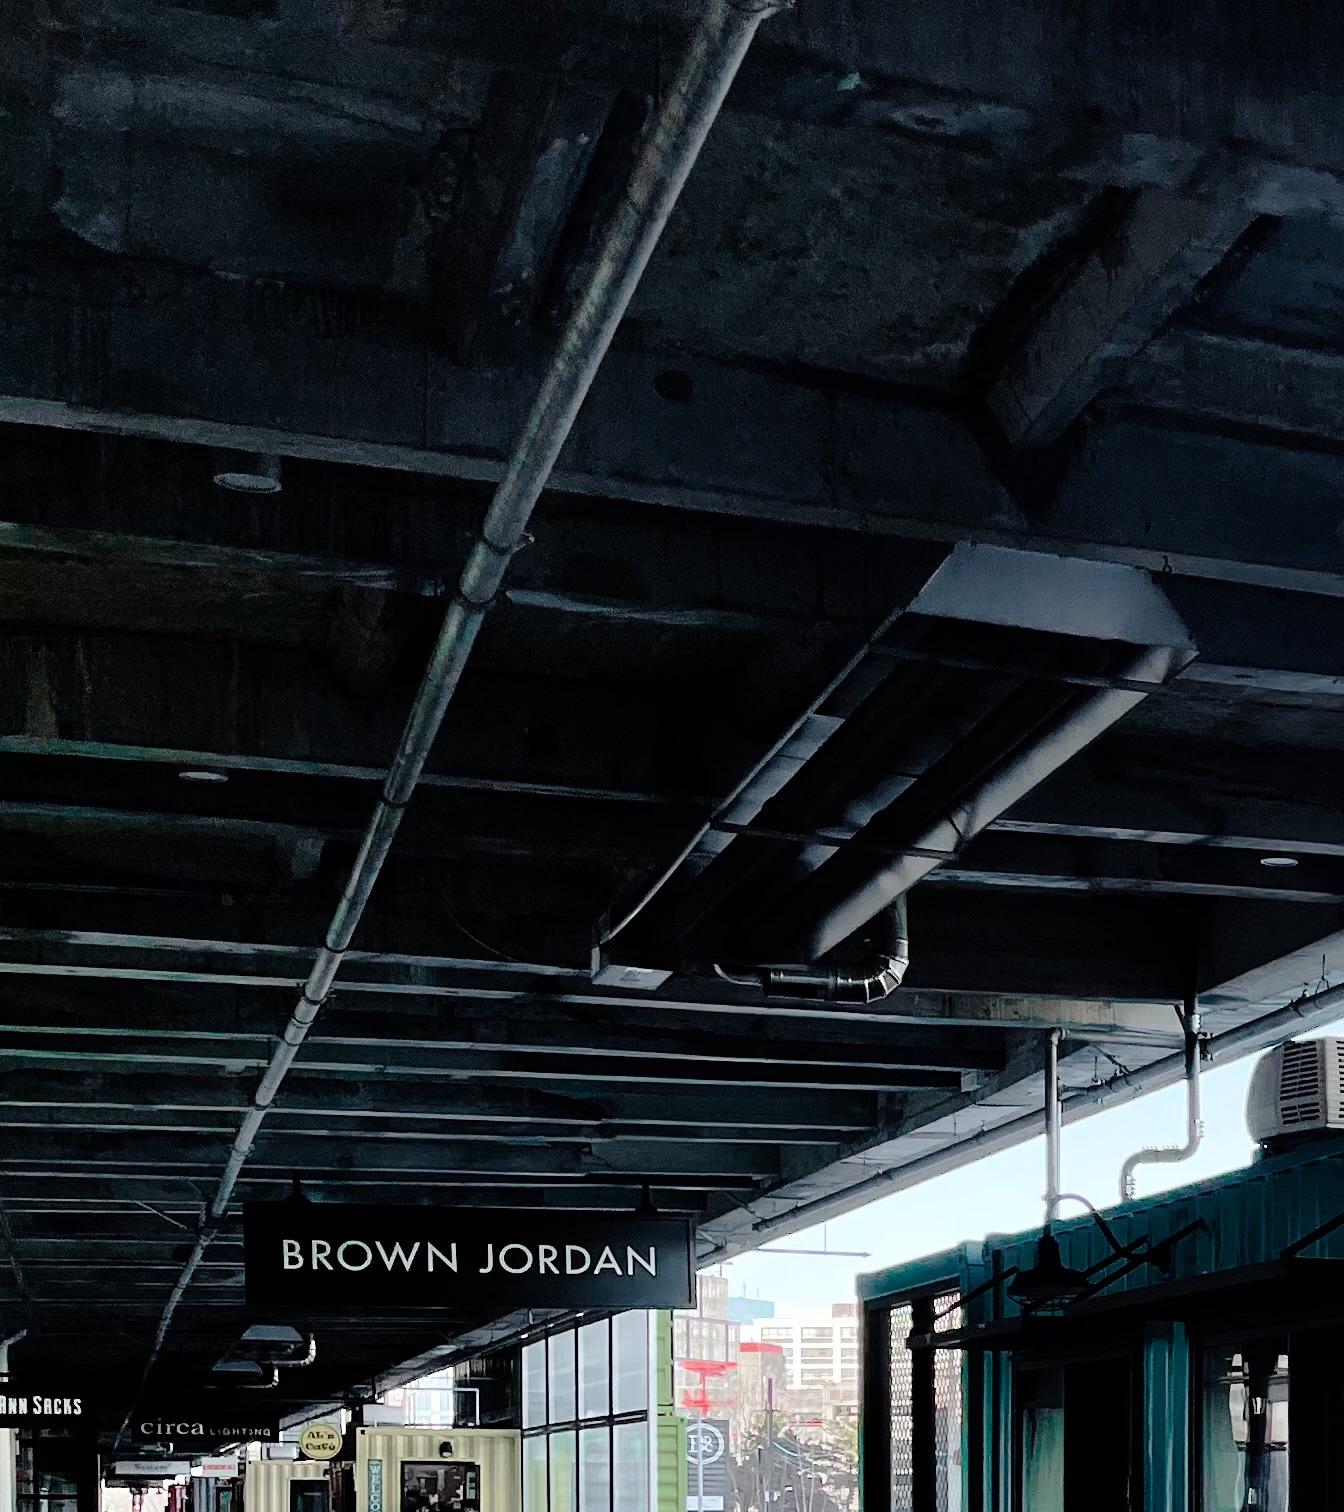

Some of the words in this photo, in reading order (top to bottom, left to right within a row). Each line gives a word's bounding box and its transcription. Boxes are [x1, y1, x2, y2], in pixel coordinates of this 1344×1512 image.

[282, 1239, 458, 1273] BROWN
[479, 1243, 657, 1277] JORDAN
[140, 1418, 204, 1435] circa
[210, 1427, 271, 1437] LIGHTING
